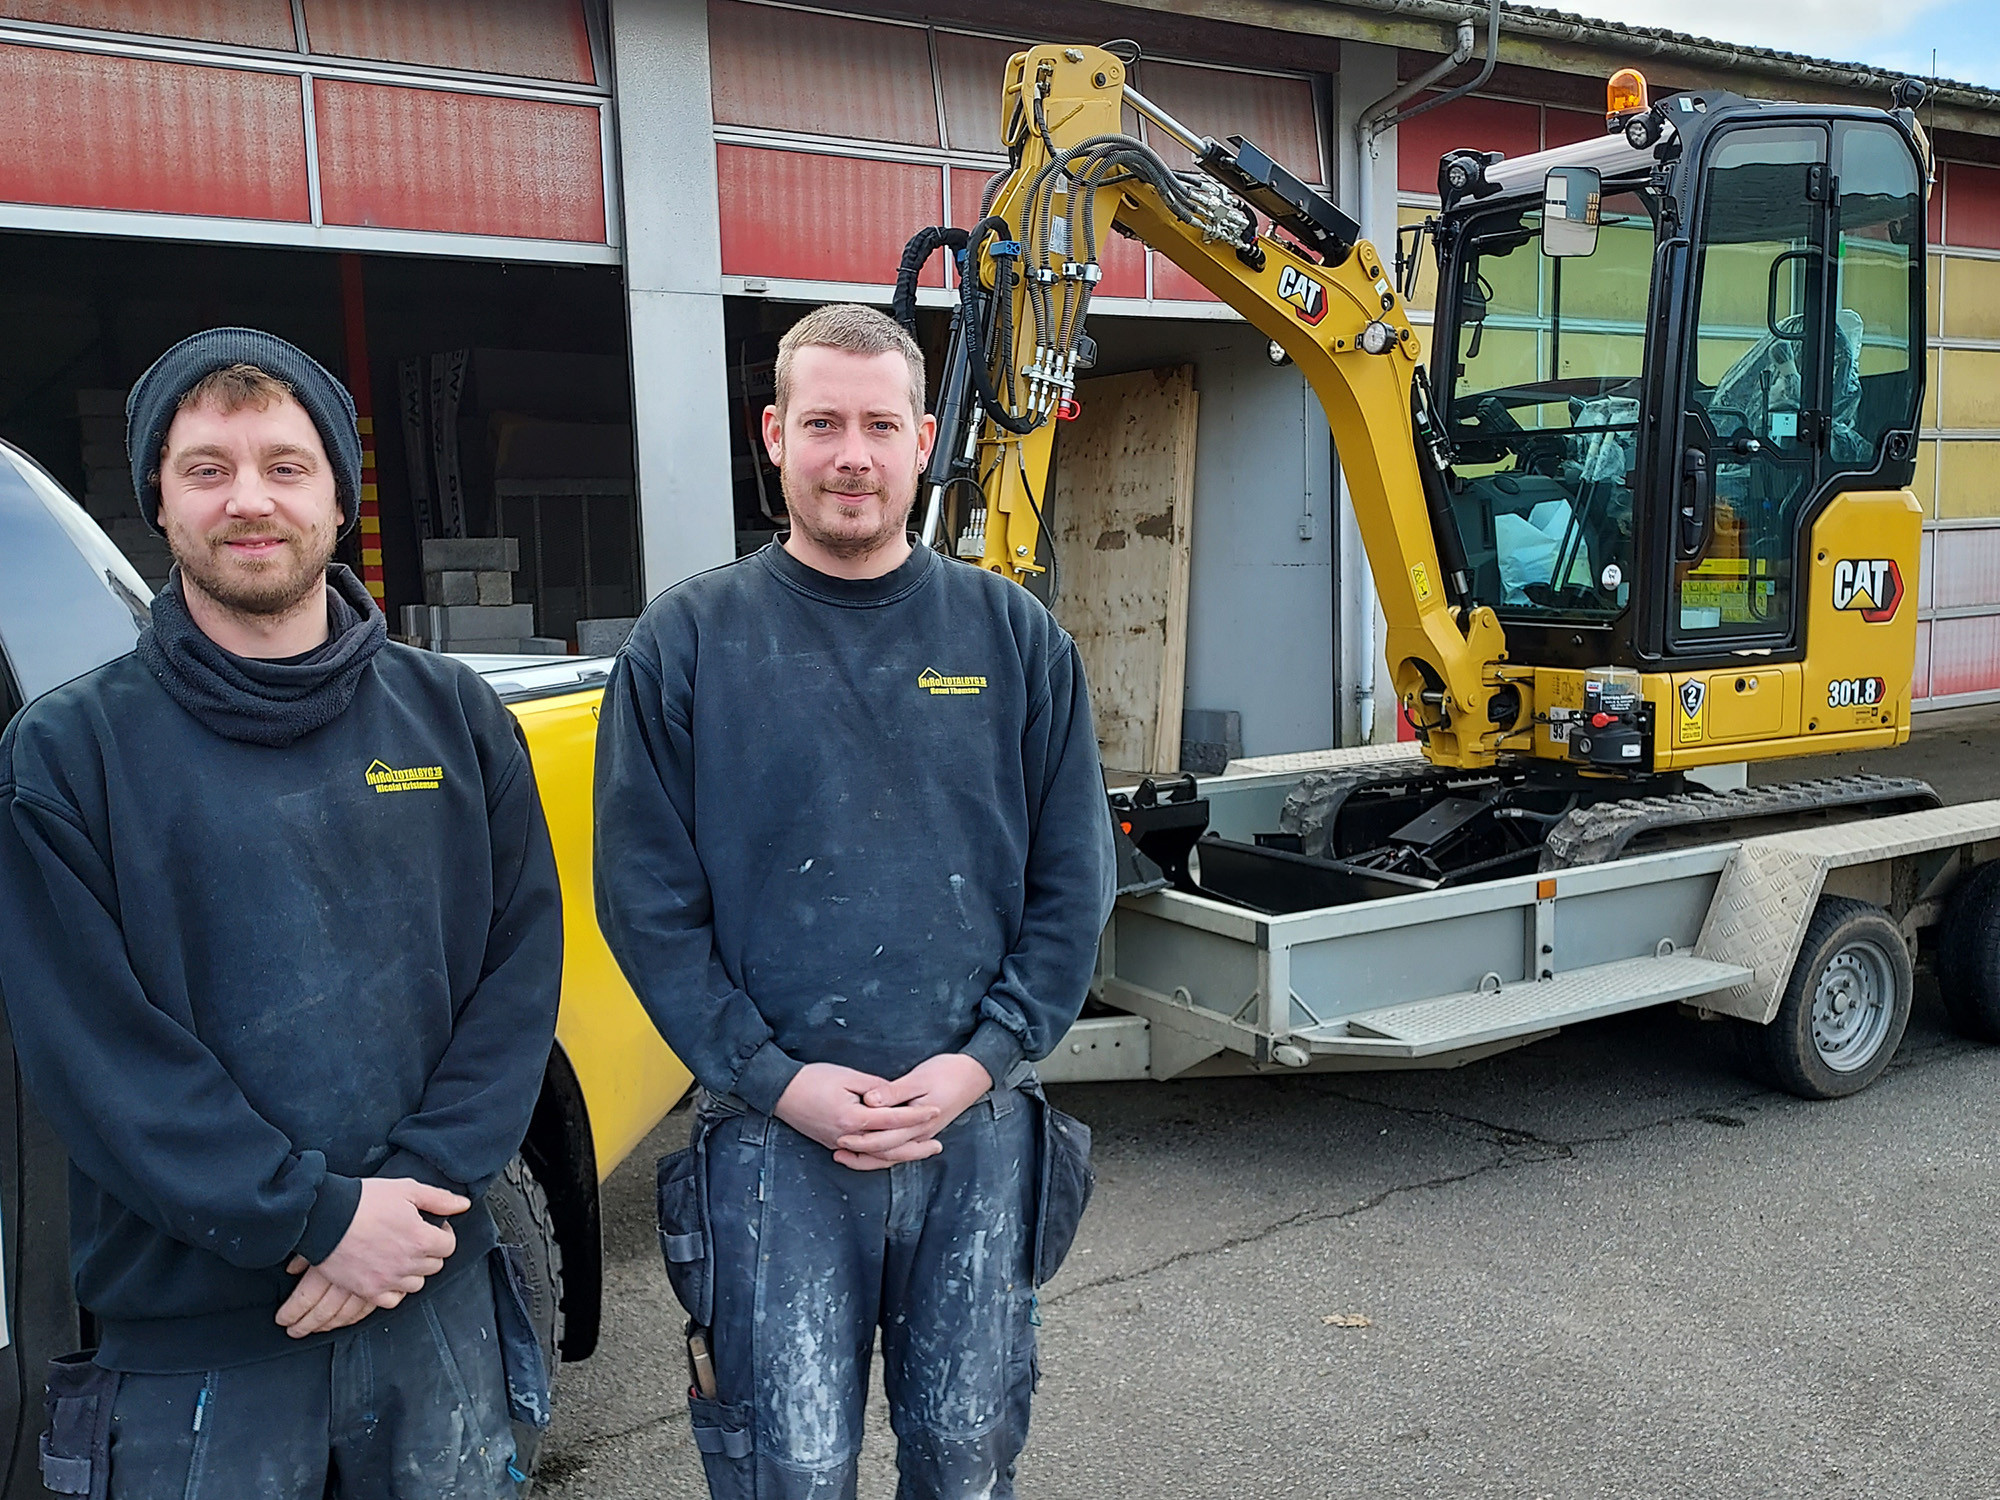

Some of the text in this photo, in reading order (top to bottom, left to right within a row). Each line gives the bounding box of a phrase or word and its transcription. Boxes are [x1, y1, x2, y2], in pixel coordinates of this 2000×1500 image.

[1278, 266, 1321, 313] CAT
[1834, 559, 1889, 609] CAT
[942, 676, 979, 685] TOTALBYG
[1687, 687, 1696, 703] 2
[1828, 678, 1876, 707] 301.8
[1553, 723, 1564, 739] 93
[393, 767, 434, 780] TOTALBYG
